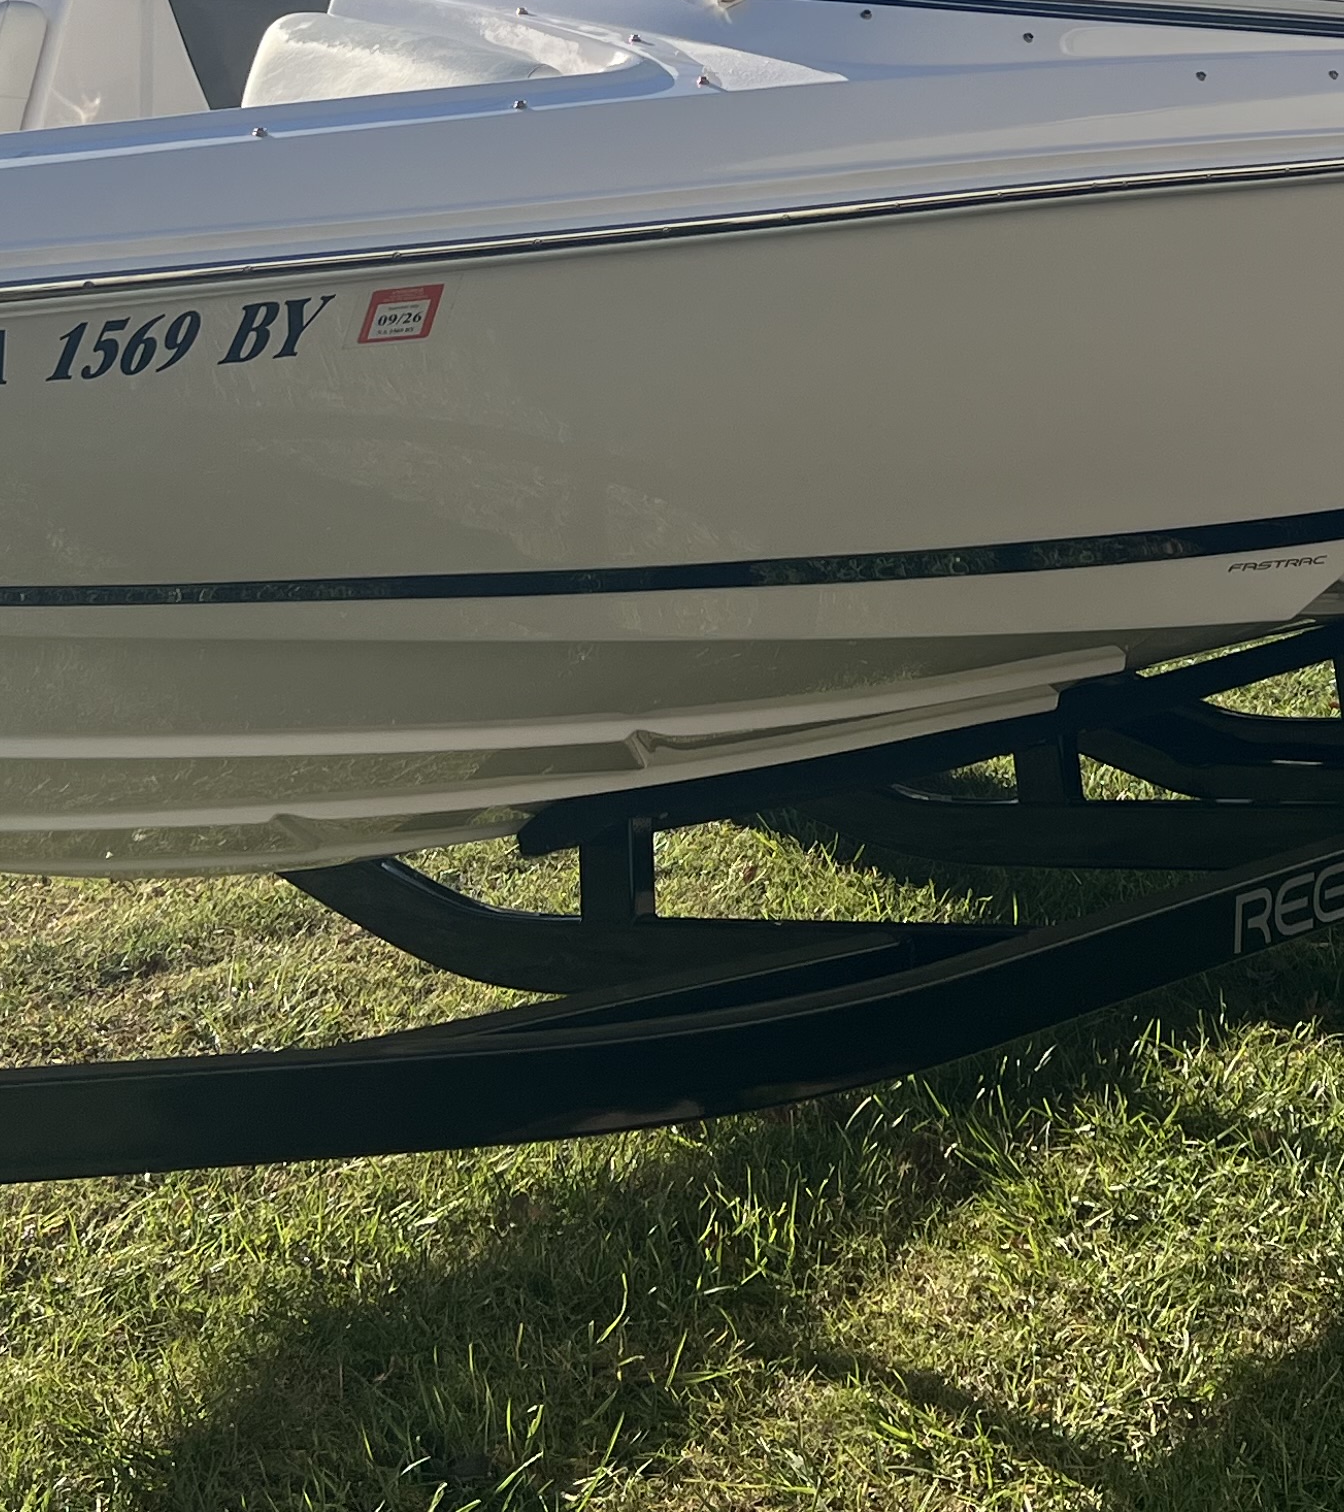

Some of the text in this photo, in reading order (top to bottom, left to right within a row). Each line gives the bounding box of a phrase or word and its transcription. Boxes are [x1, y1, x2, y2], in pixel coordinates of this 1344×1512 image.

[377, 311, 423, 327] 09/26
[45, 310, 202, 382] 1569
[216, 293, 336, 367] BY
[1227, 554, 1328, 573] FASTRAC
